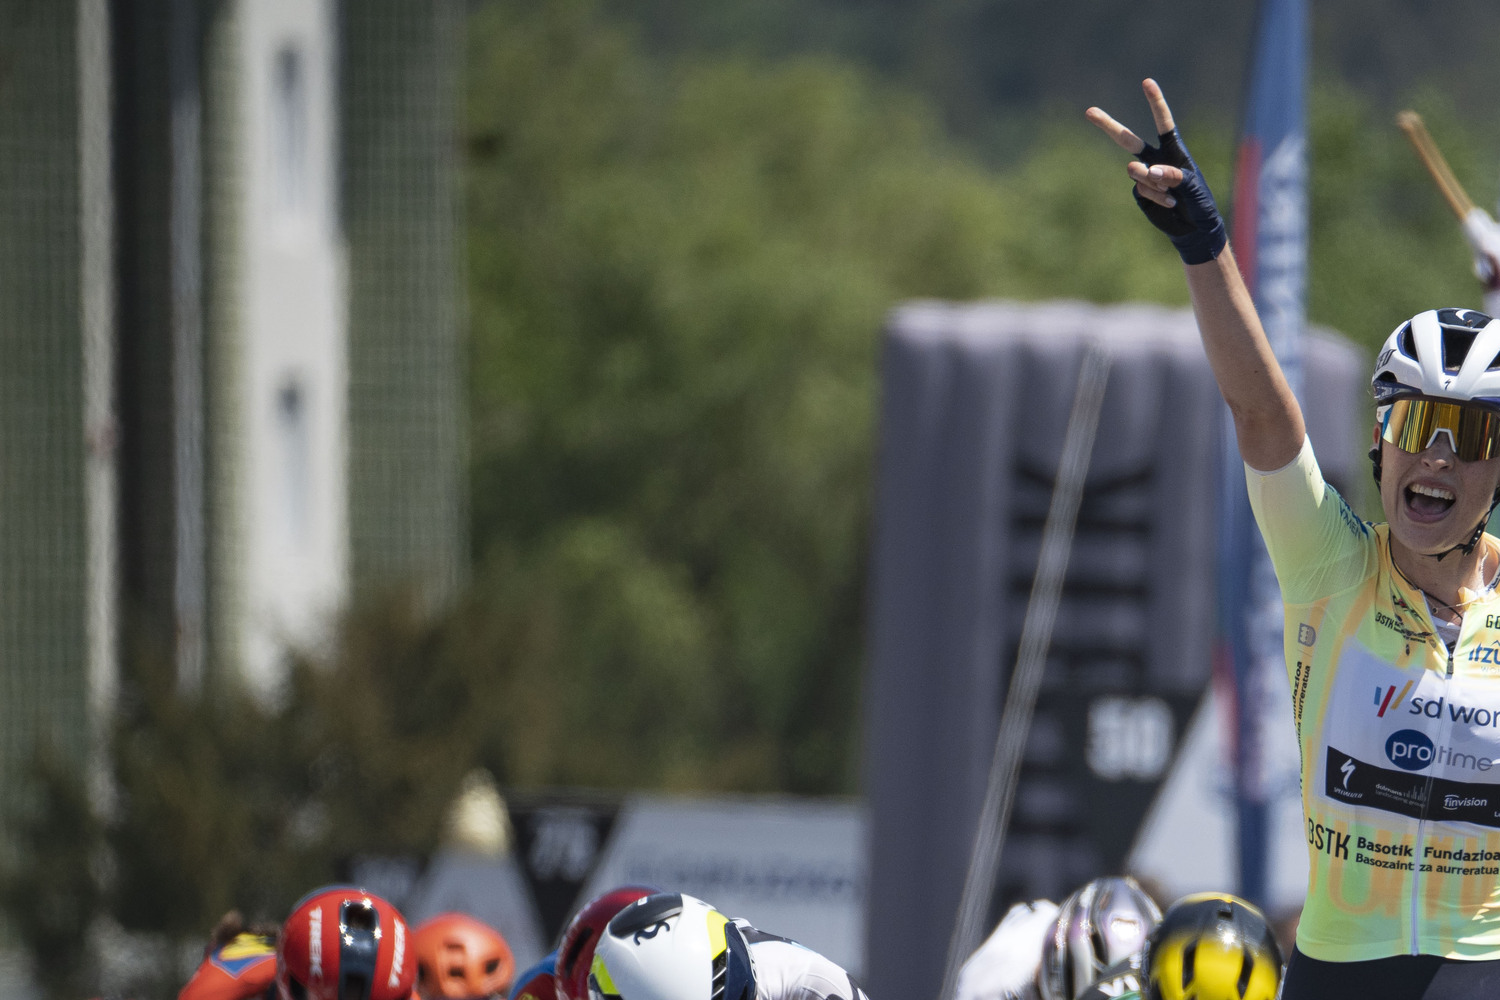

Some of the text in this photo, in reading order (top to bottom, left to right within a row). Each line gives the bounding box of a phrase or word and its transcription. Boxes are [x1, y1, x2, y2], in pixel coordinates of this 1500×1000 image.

[1409, 696, 1444, 719] sd
[1444, 795, 1488, 808] finvision
[1308, 817, 1351, 860] BSTK
[1357, 836, 1500, 862] Basotik Fundazioa
[1435, 864, 1500, 876] aurreratua
[309, 905, 322, 977] TREK
